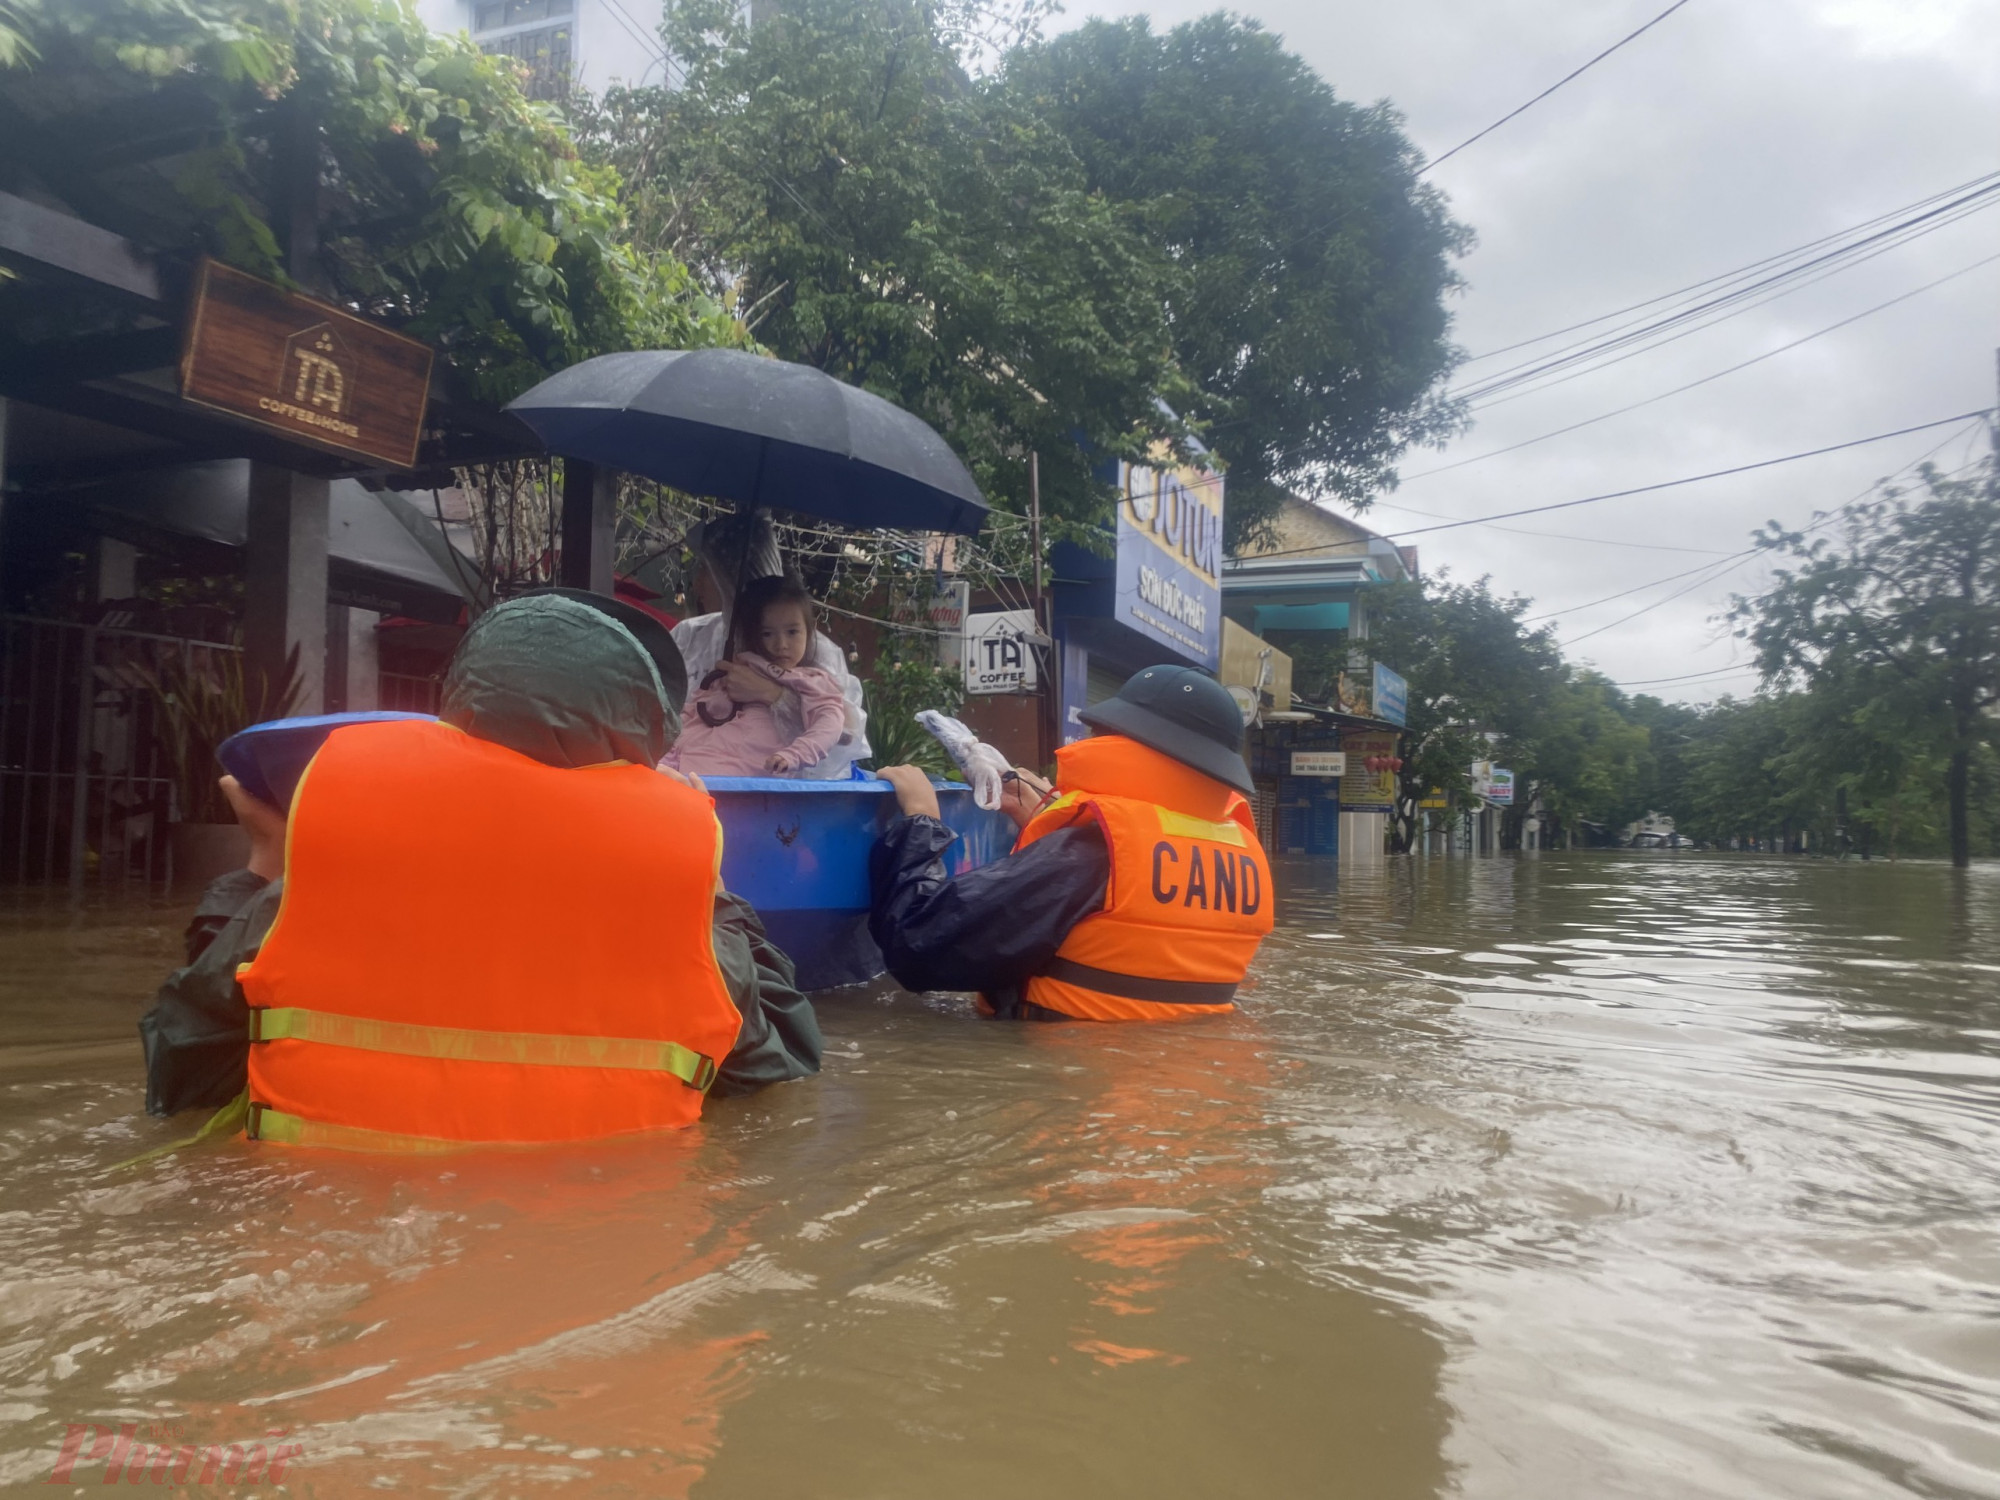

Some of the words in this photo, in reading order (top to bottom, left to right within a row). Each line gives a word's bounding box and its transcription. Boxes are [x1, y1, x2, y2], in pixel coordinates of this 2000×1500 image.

[1153, 471, 1219, 579] JOTUN
[980, 672, 1025, 683] COFFEE
[1152, 840, 1261, 916] CAND
